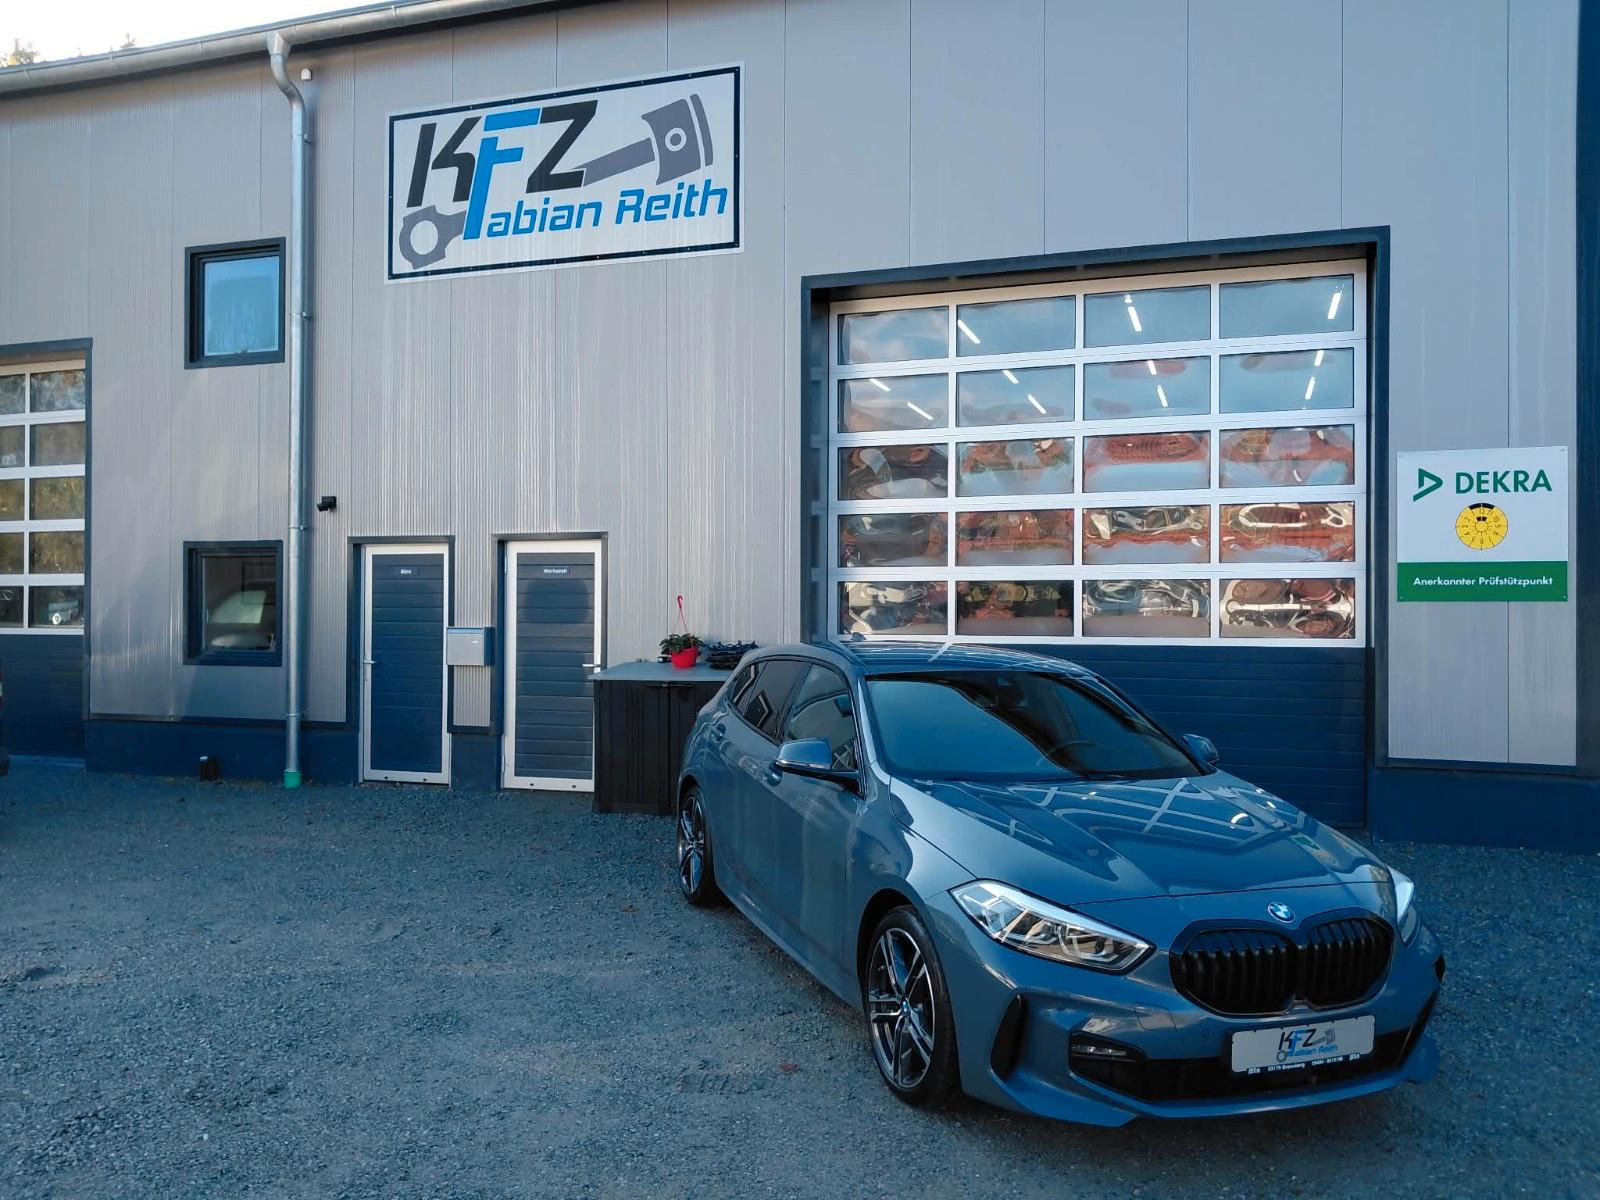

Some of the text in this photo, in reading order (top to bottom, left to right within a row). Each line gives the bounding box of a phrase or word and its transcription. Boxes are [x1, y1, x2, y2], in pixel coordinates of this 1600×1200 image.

[406, 99, 599, 240] KFZ
[615, 178, 728, 225] Reith
[1455, 469, 1552, 494] DEKRA
[1413, 575, 1553, 588] Anerkannter Prüfstützpunkt
